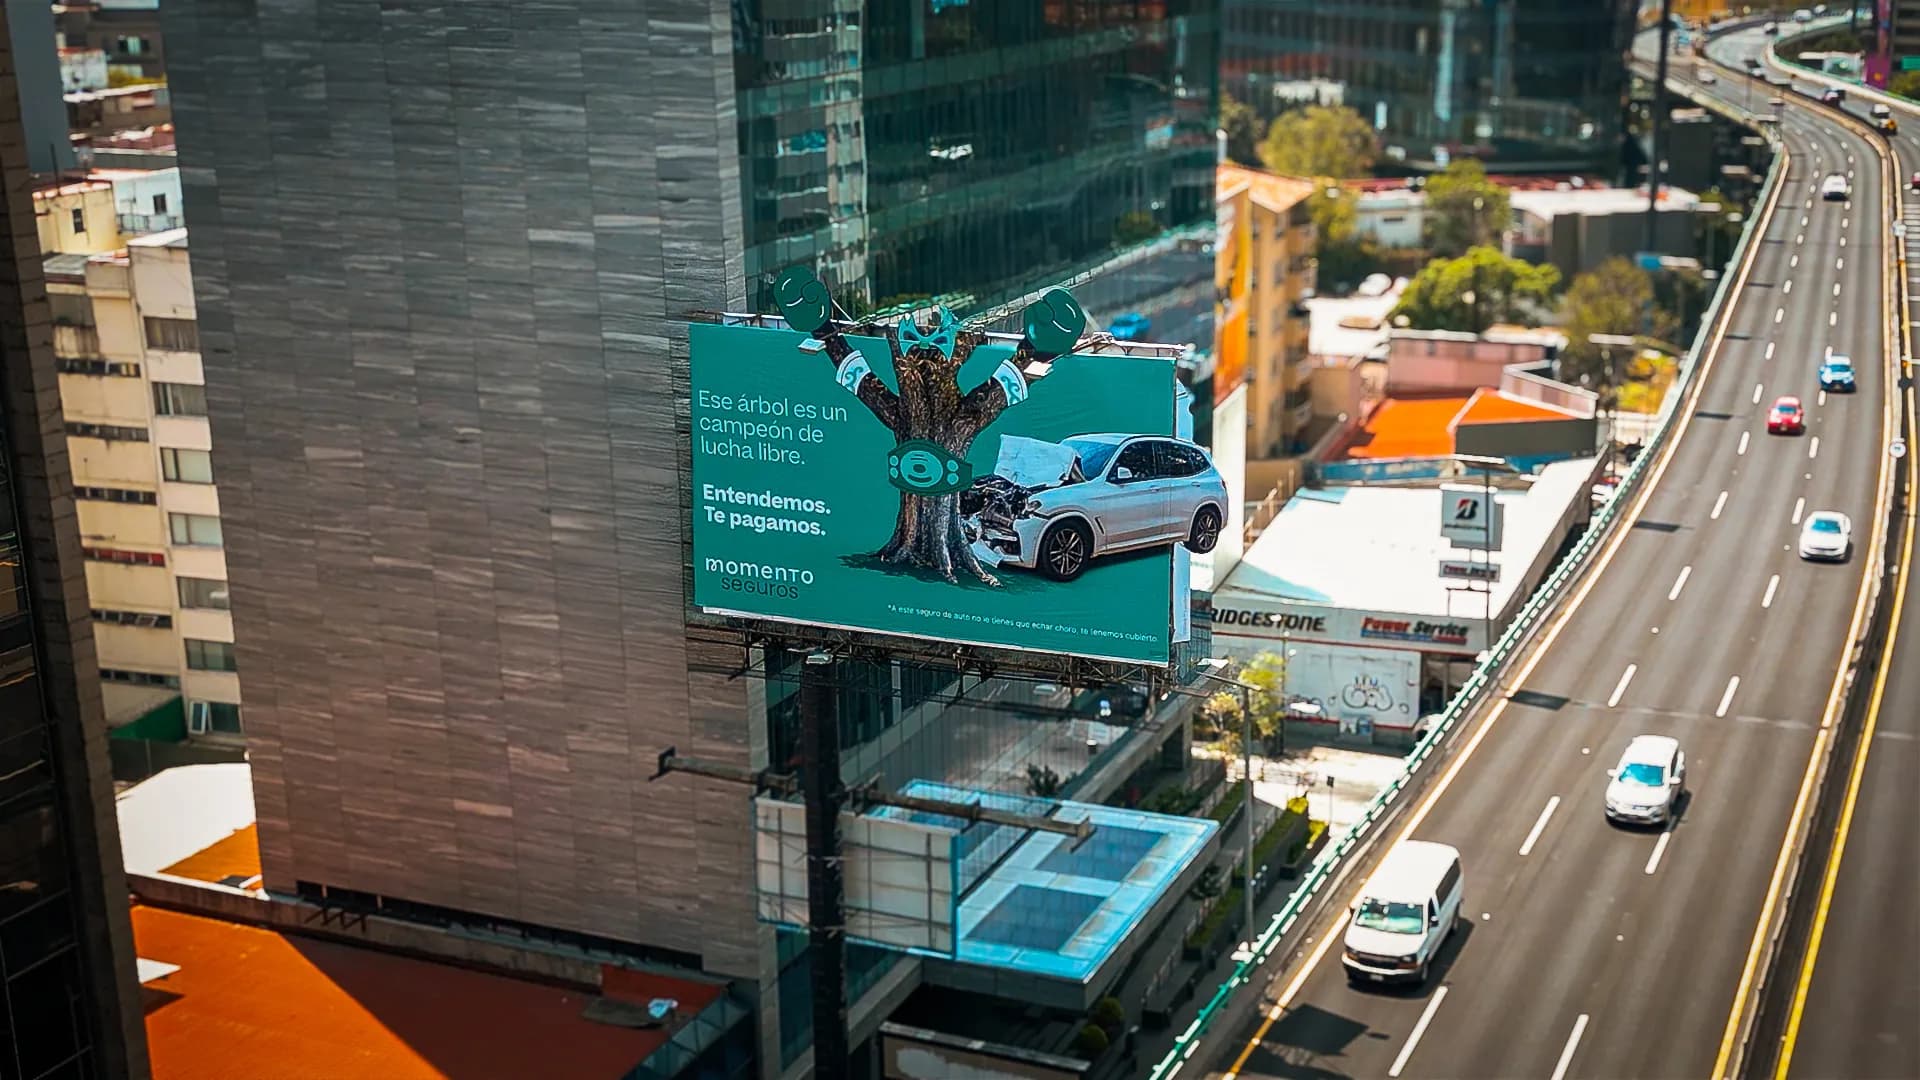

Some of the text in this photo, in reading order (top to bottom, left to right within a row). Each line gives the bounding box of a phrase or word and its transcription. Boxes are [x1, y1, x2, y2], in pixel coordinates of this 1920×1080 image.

[698, 389, 848, 422] Ese árbol es un
[699, 416, 824, 443] campeón de
[700, 435, 806, 465] lucha libre.
[702, 483, 832, 515] Entendemos.
[703, 505, 826, 536] Te pagamos.
[721, 576, 799, 600] seguros
[898, 606, 914, 615] este
[915, 608, 941, 618] seguro
[942, 610, 953, 619] de
[953, 612, 970, 621] auto
[971, 614, 982, 622] no
[991, 616, 1014, 626] tienes
[1015, 620, 1030, 629] que
[1031, 621, 1053, 631] echar
[1080, 627, 1089, 635] te
[1090, 628, 1124, 639] tenemos
[1210, 607, 1327, 633] RIDGESTONE
[1361, 616, 1469, 636] Power Service
